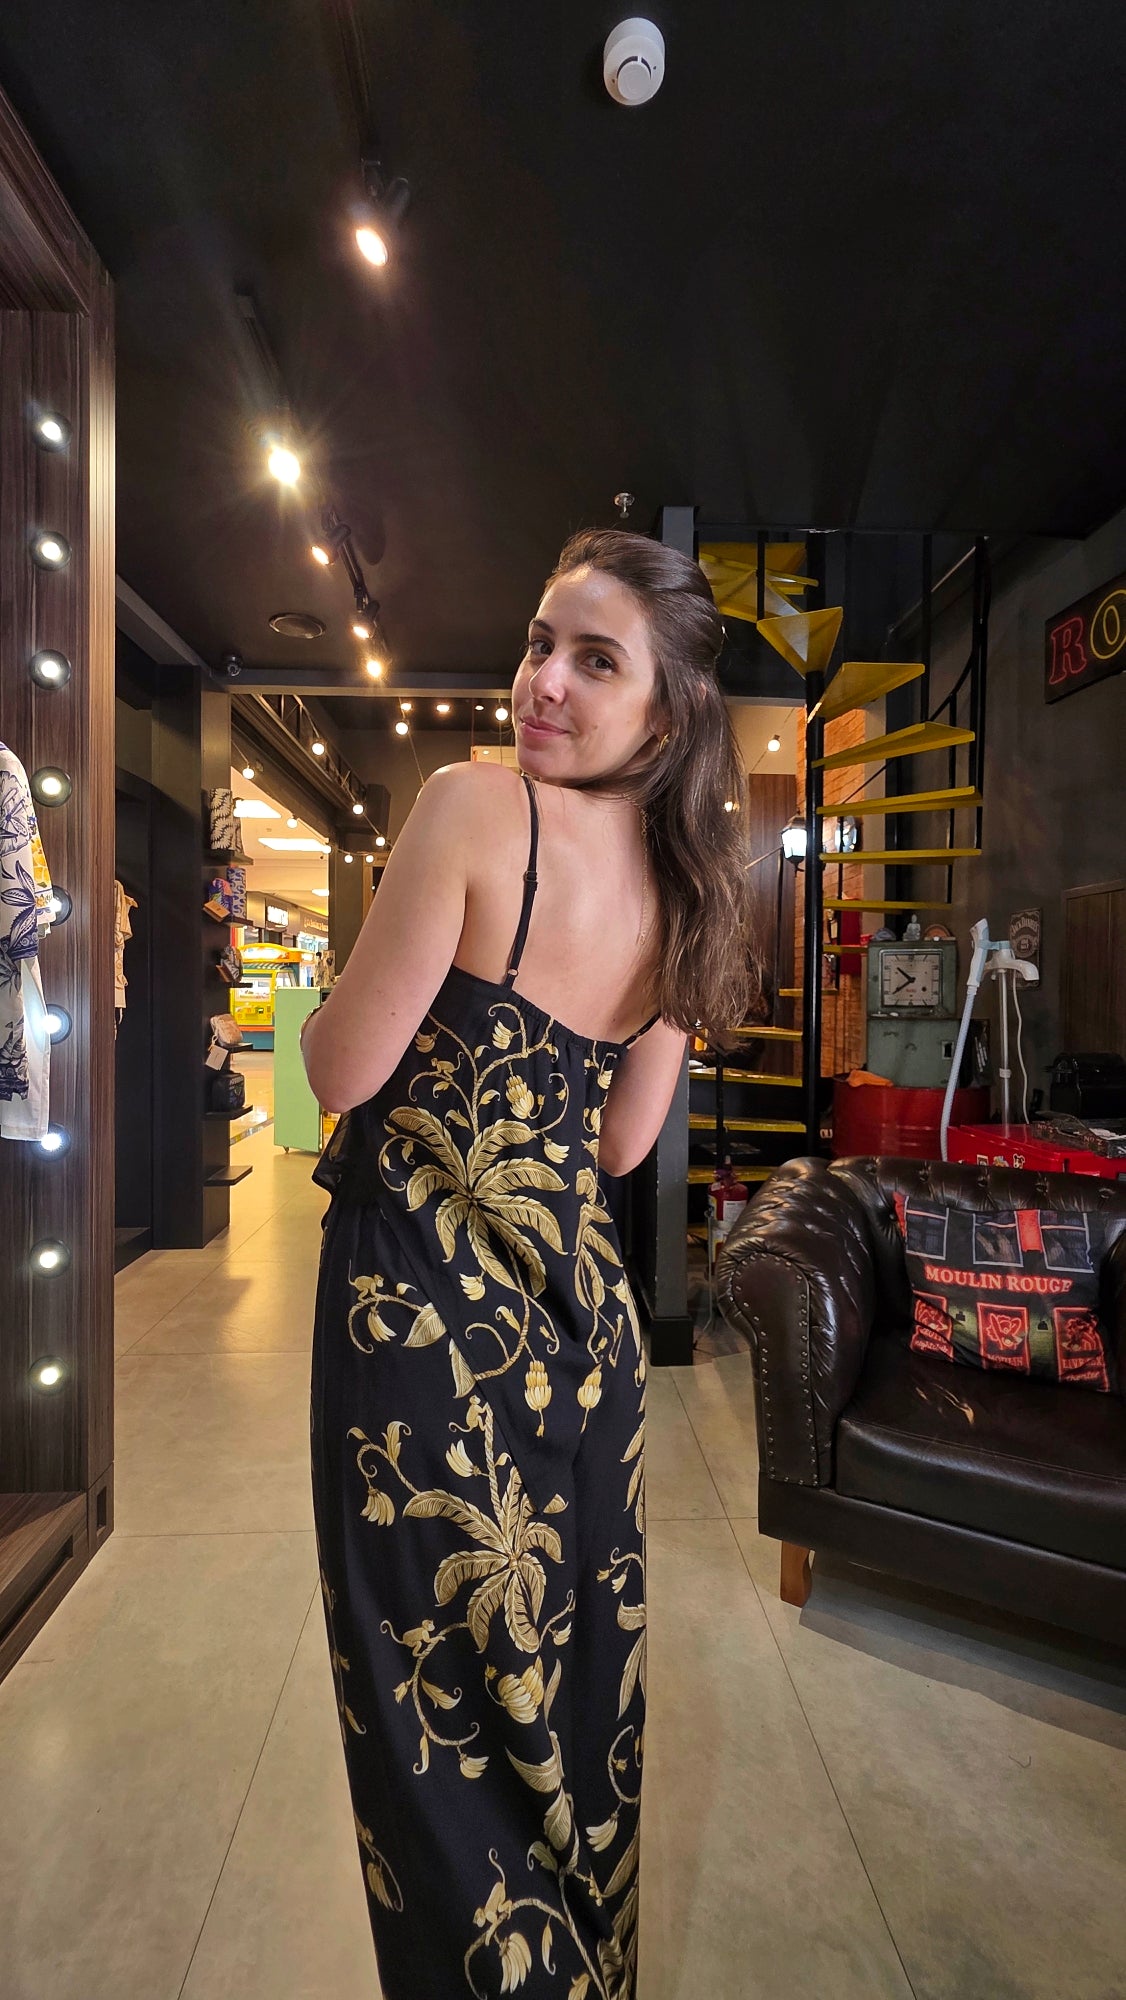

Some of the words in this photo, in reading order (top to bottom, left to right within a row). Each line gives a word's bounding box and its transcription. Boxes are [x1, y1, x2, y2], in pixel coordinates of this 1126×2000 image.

[1049, 589, 1126, 685] RO
[925, 1265, 1003, 1290] MOULIN
[1005, 1274, 1073, 1294] ROUGE
